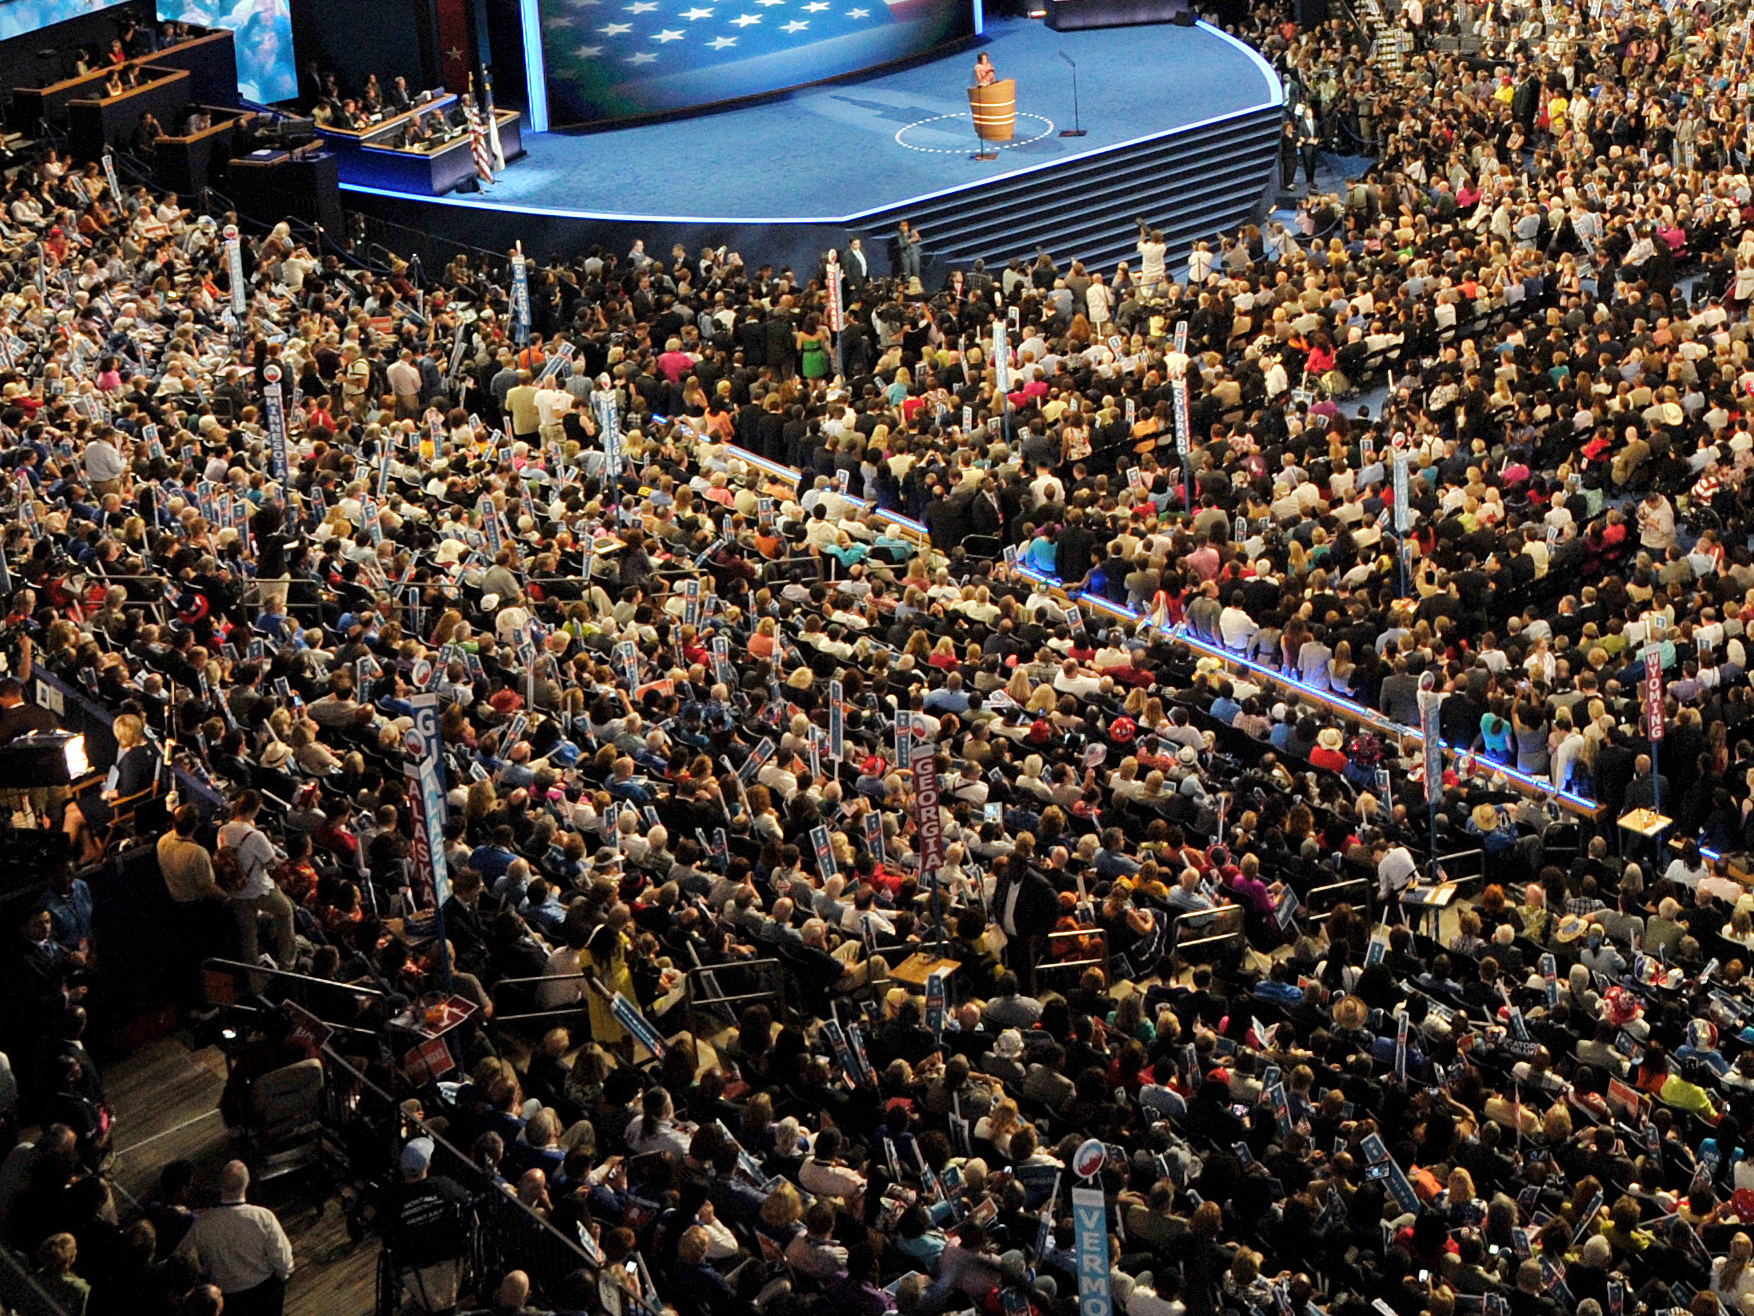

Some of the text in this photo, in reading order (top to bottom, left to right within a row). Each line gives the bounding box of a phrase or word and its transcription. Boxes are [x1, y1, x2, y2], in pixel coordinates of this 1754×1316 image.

[828, 272, 837, 331] DELAWARE
[266, 397, 286, 483] MINNESOTA
[608, 401, 623, 475] MICHIGAN
[1174, 388, 1187, 455] COLORADO
[1647, 652, 1662, 738] WYOMING
[408, 781, 436, 904] ALASKA
[424, 775, 450, 905] ALASKA
[915, 758, 943, 869] GEORGIA
